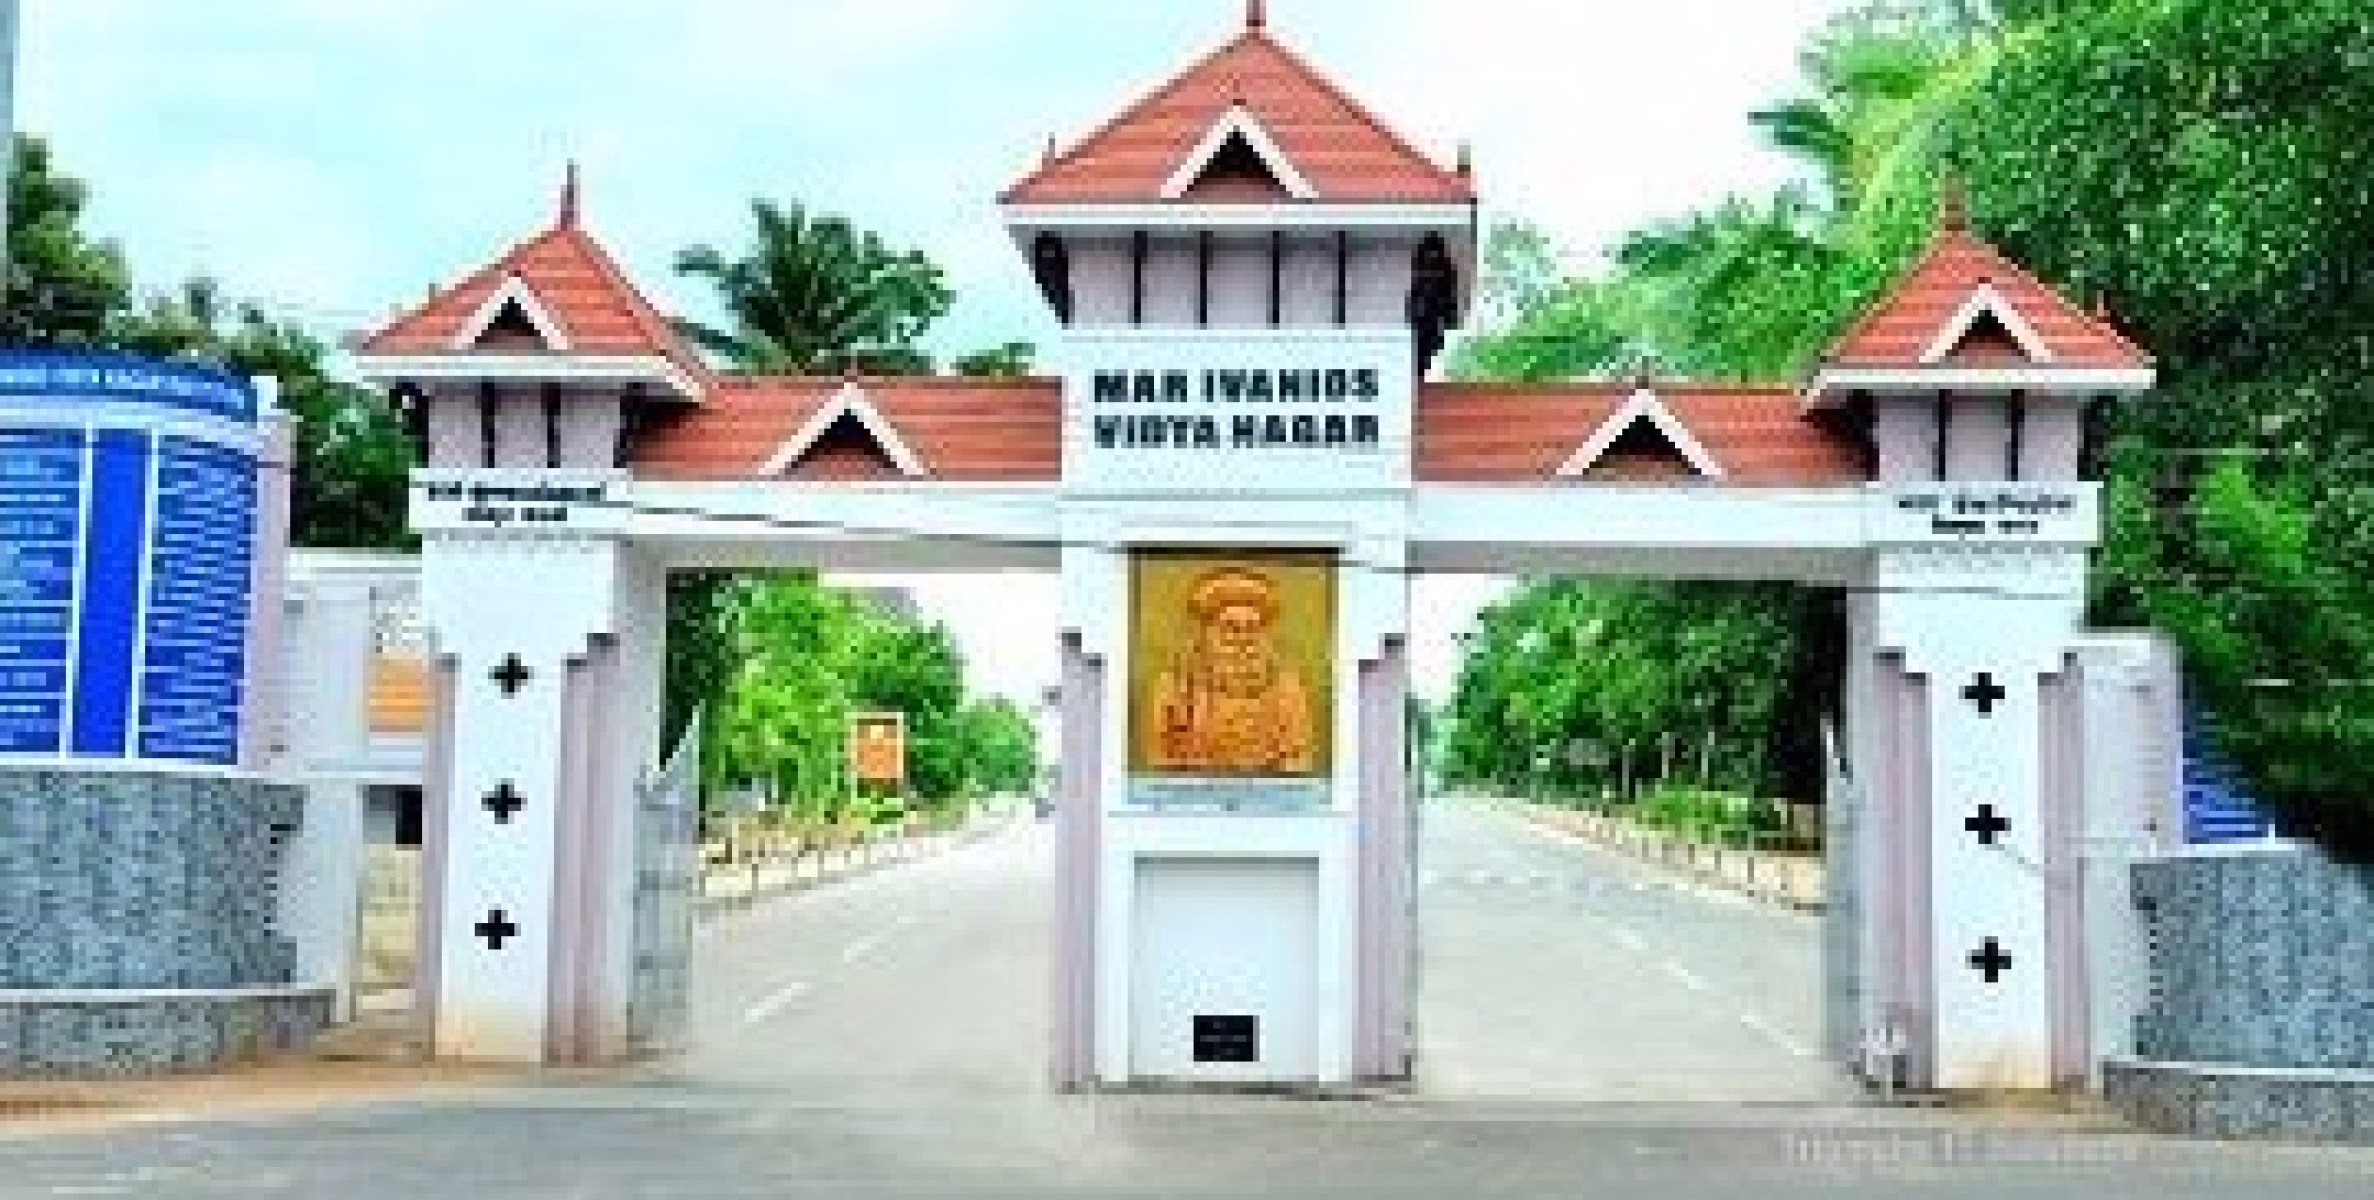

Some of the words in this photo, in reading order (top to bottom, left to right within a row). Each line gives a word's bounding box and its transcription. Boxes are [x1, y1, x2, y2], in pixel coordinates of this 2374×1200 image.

[1094, 369, 1187, 402] MAR
[1201, 369, 1378, 402] IVANIOS
[1094, 415, 1219, 448] VIDYA
[1232, 415, 1378, 448] NAGAR
